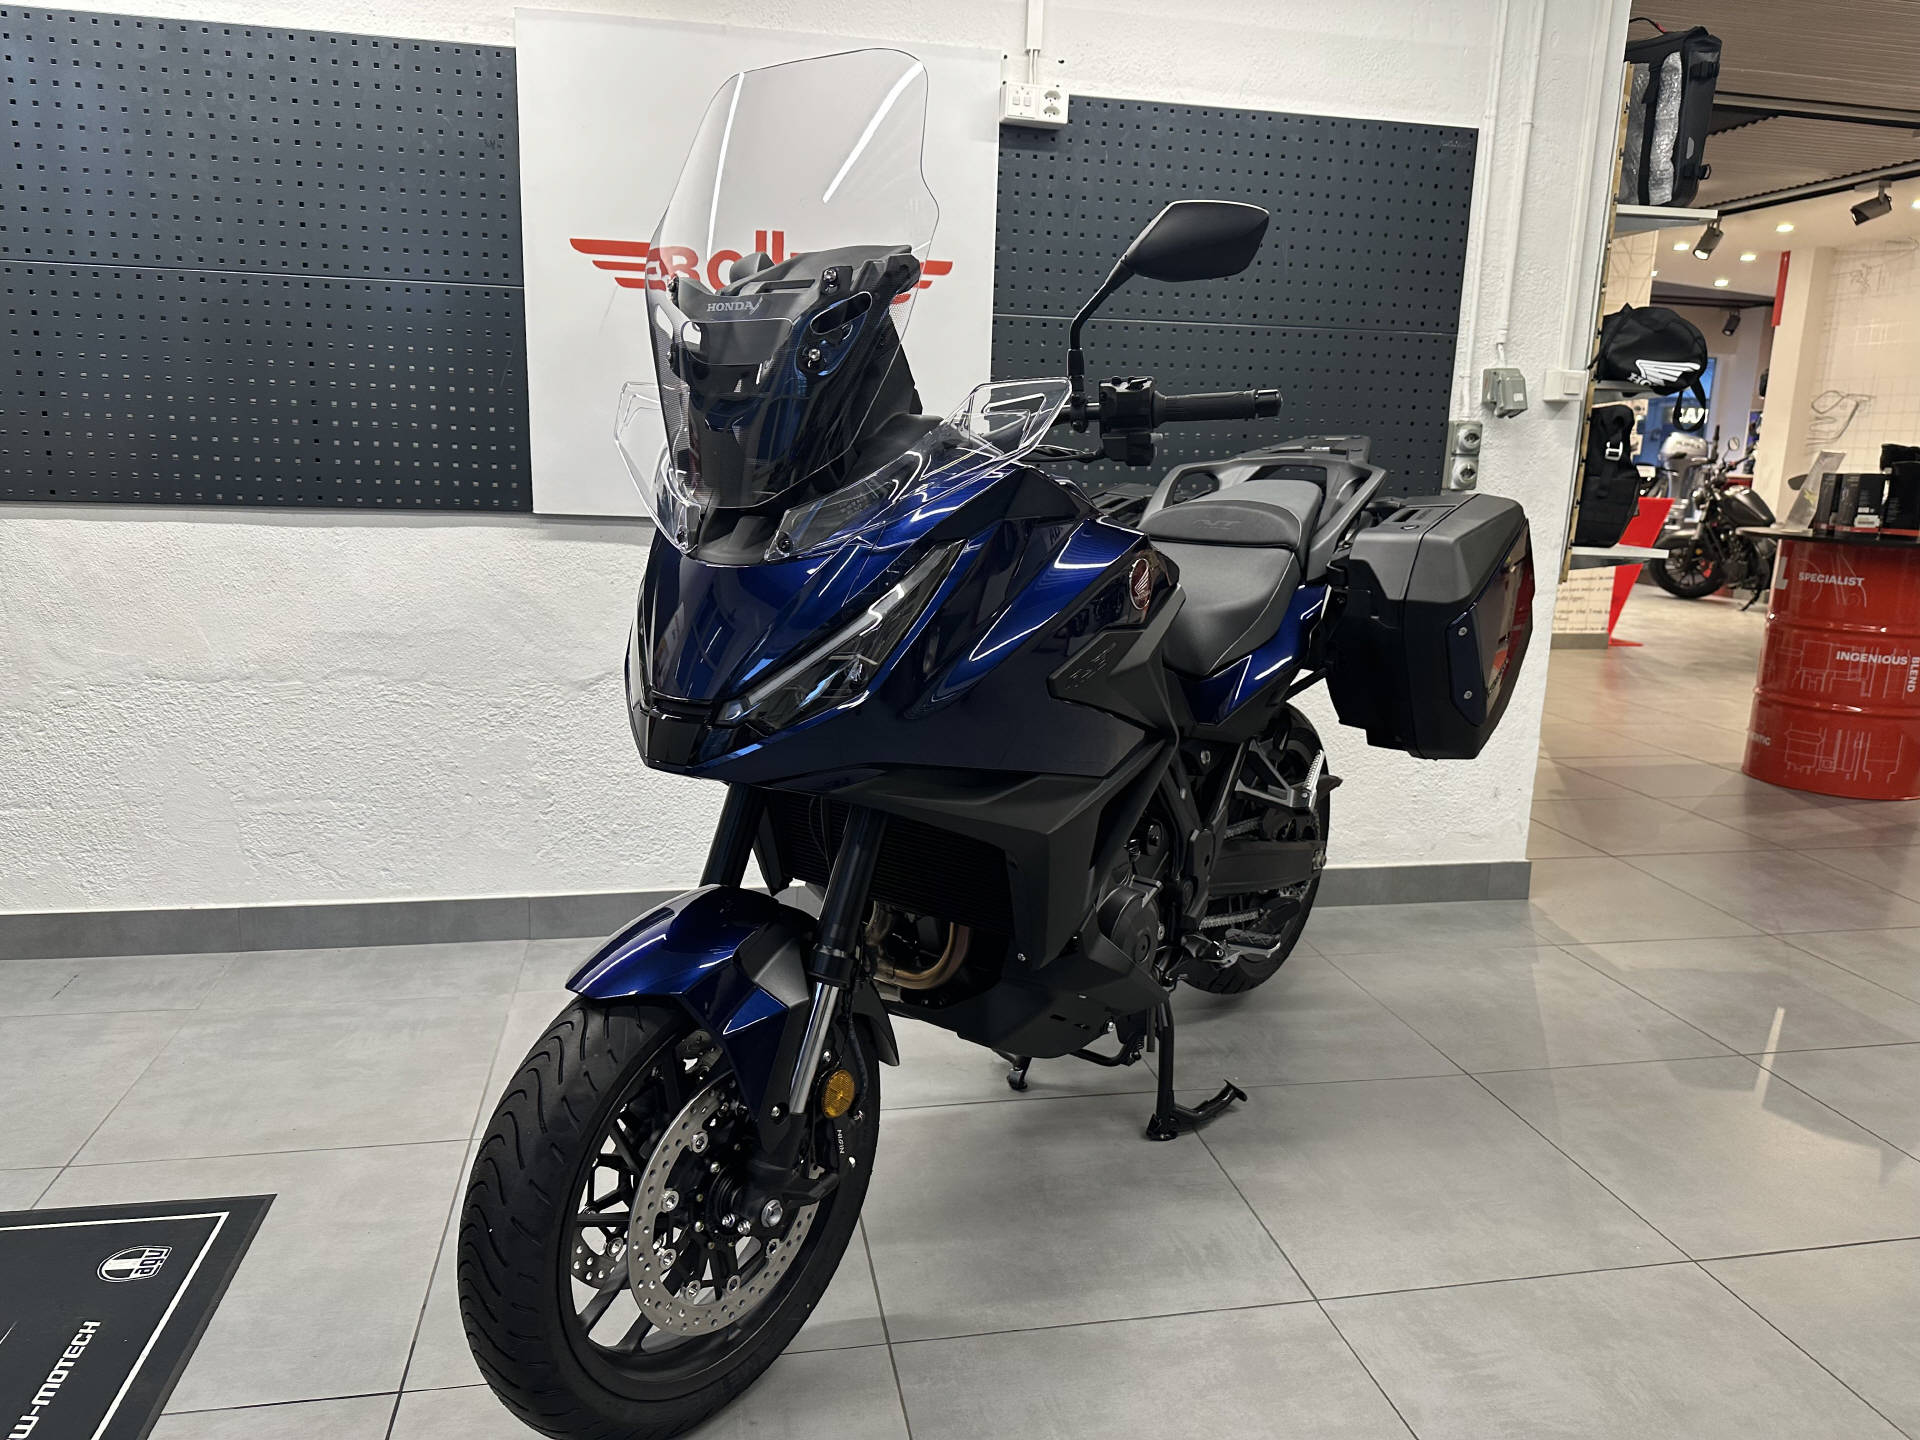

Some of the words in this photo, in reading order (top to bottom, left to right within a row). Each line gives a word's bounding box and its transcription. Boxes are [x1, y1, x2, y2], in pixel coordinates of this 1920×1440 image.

[706, 301, 755, 312] HONDA
[1798, 571, 1865, 587] SPECIALIST
[1836, 650, 1908, 666] INGENIOUS
[1906, 656, 1920, 693] BLEND
[5, 1321, 101, 1440] W-MOTECH
